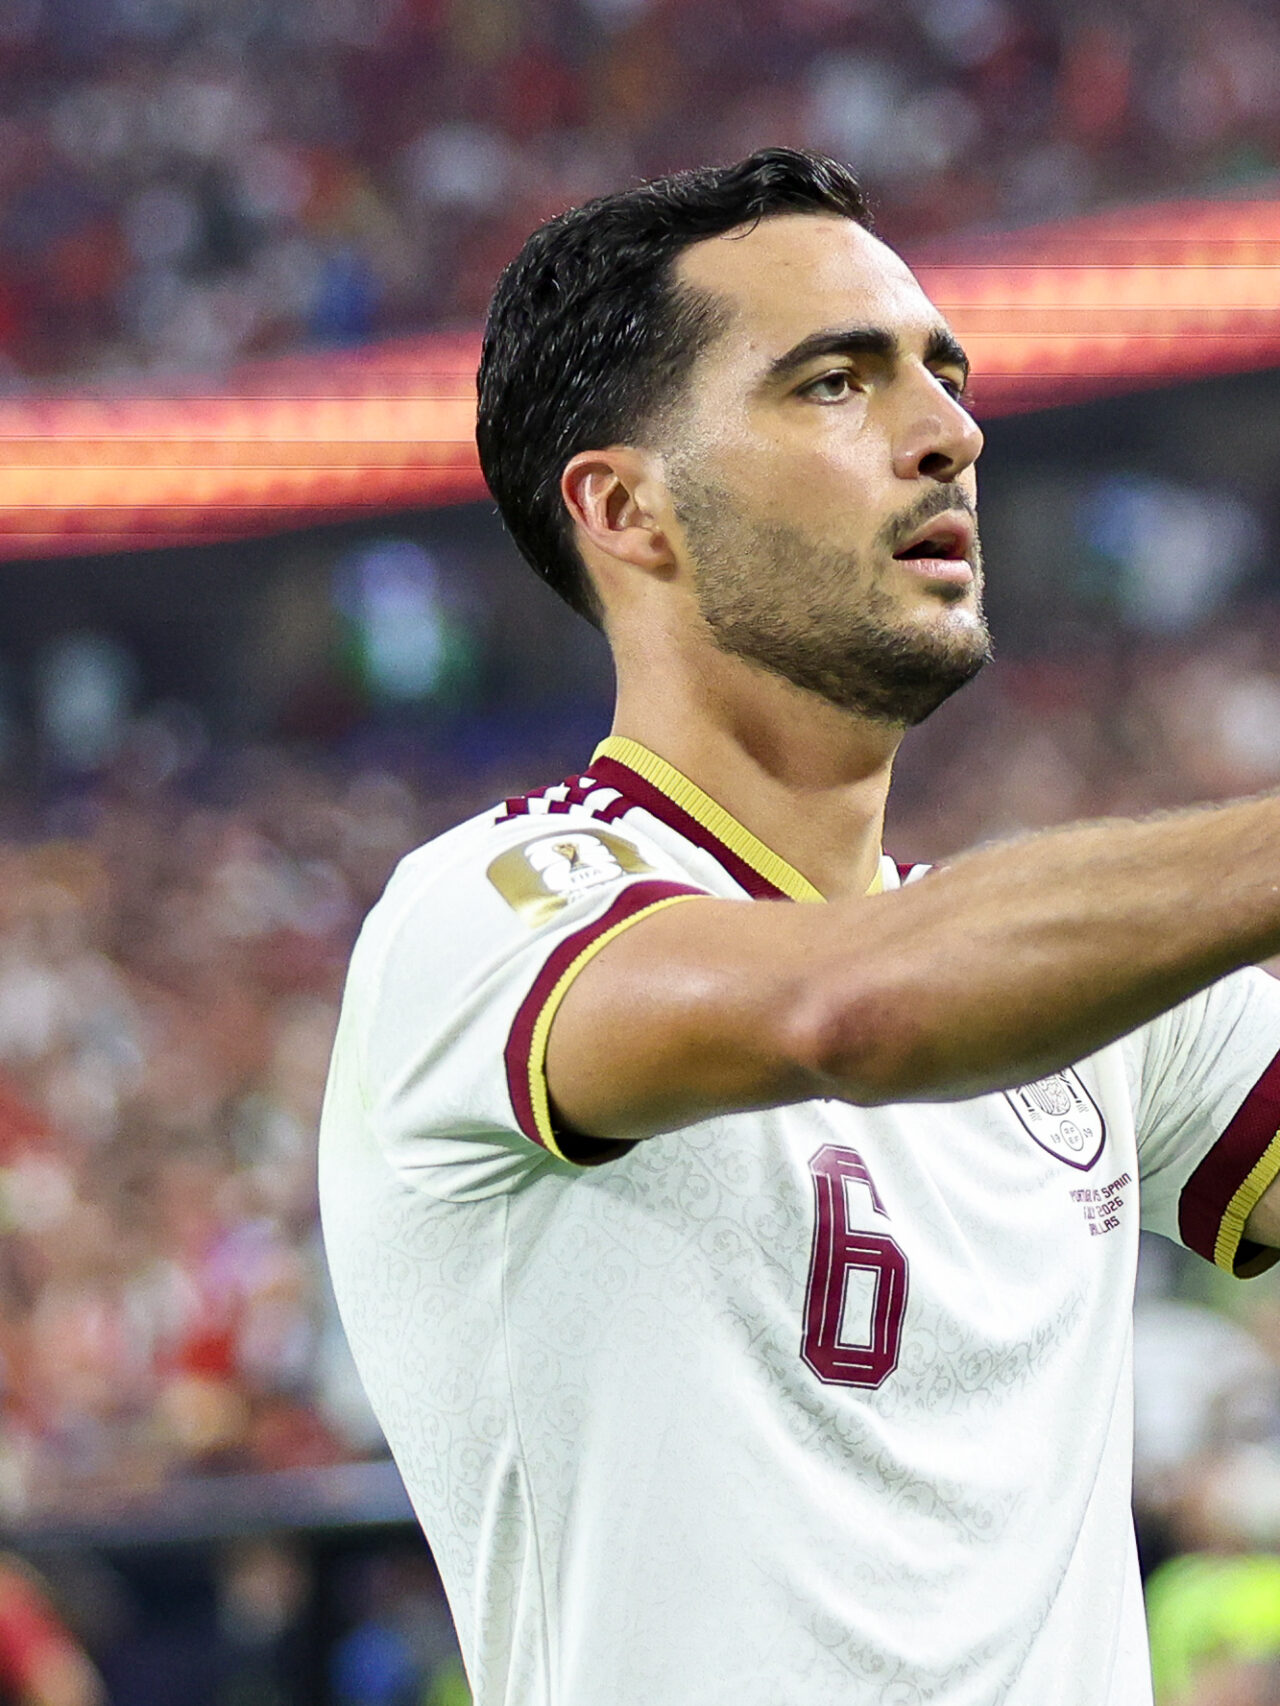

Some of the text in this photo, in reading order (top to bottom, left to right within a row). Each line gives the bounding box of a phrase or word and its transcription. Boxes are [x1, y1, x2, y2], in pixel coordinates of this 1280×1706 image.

[1101, 1172, 1132, 1199] SPAIN
[1095, 1196, 1124, 1218] 2026
[800, 1143, 909, 1390] 6
